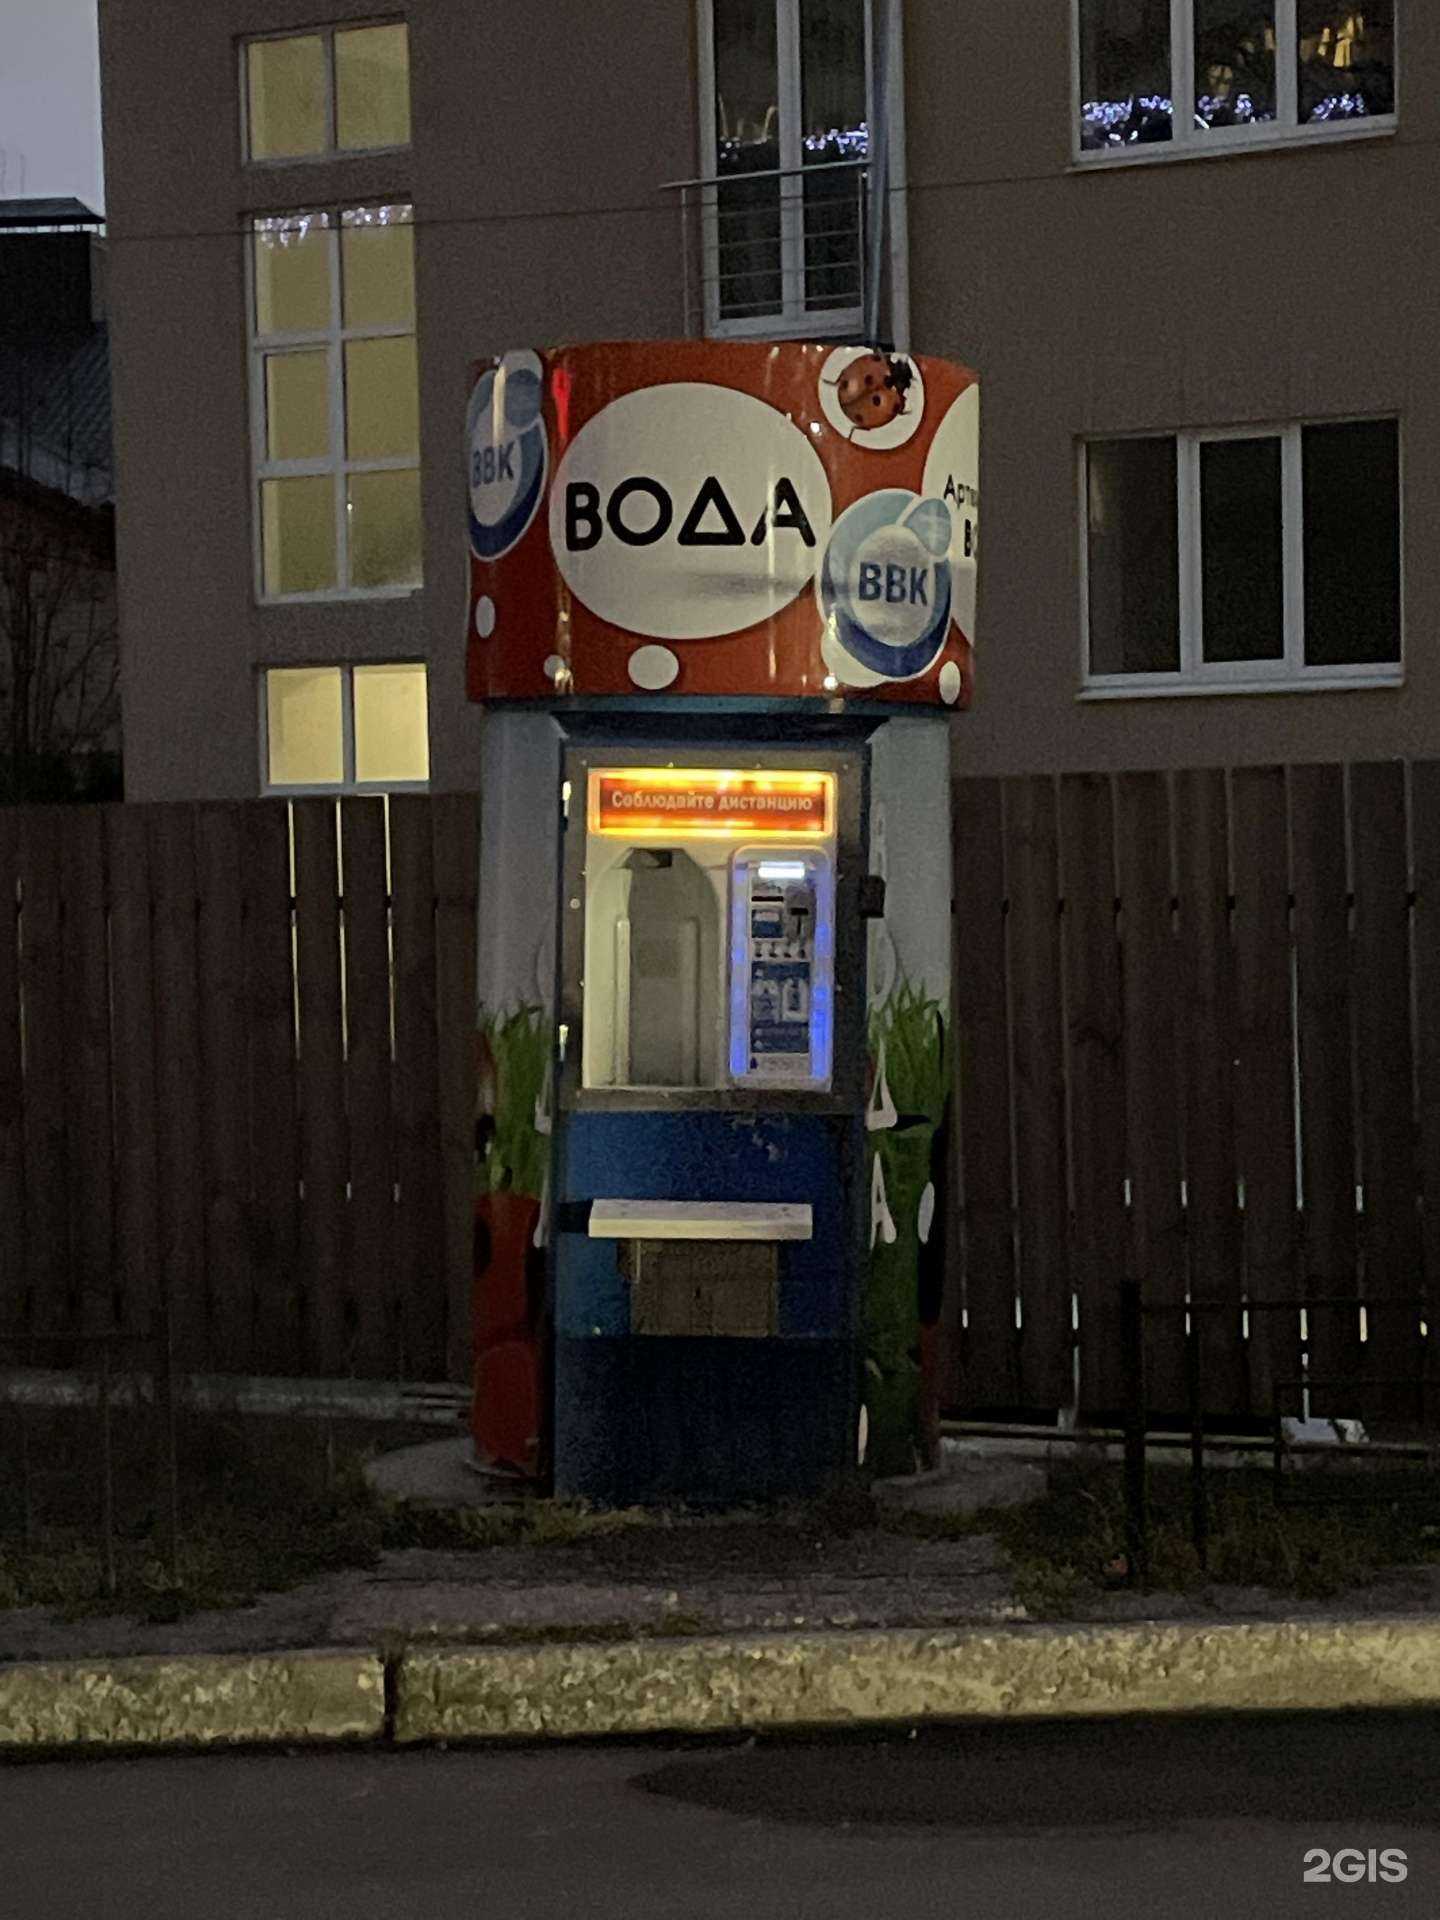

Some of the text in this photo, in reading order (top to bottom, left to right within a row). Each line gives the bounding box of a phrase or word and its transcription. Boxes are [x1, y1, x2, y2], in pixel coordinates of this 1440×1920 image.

[565, 475, 817, 551] ВОДА
[611, 791, 814, 811] Соблюдайте дистанцию
